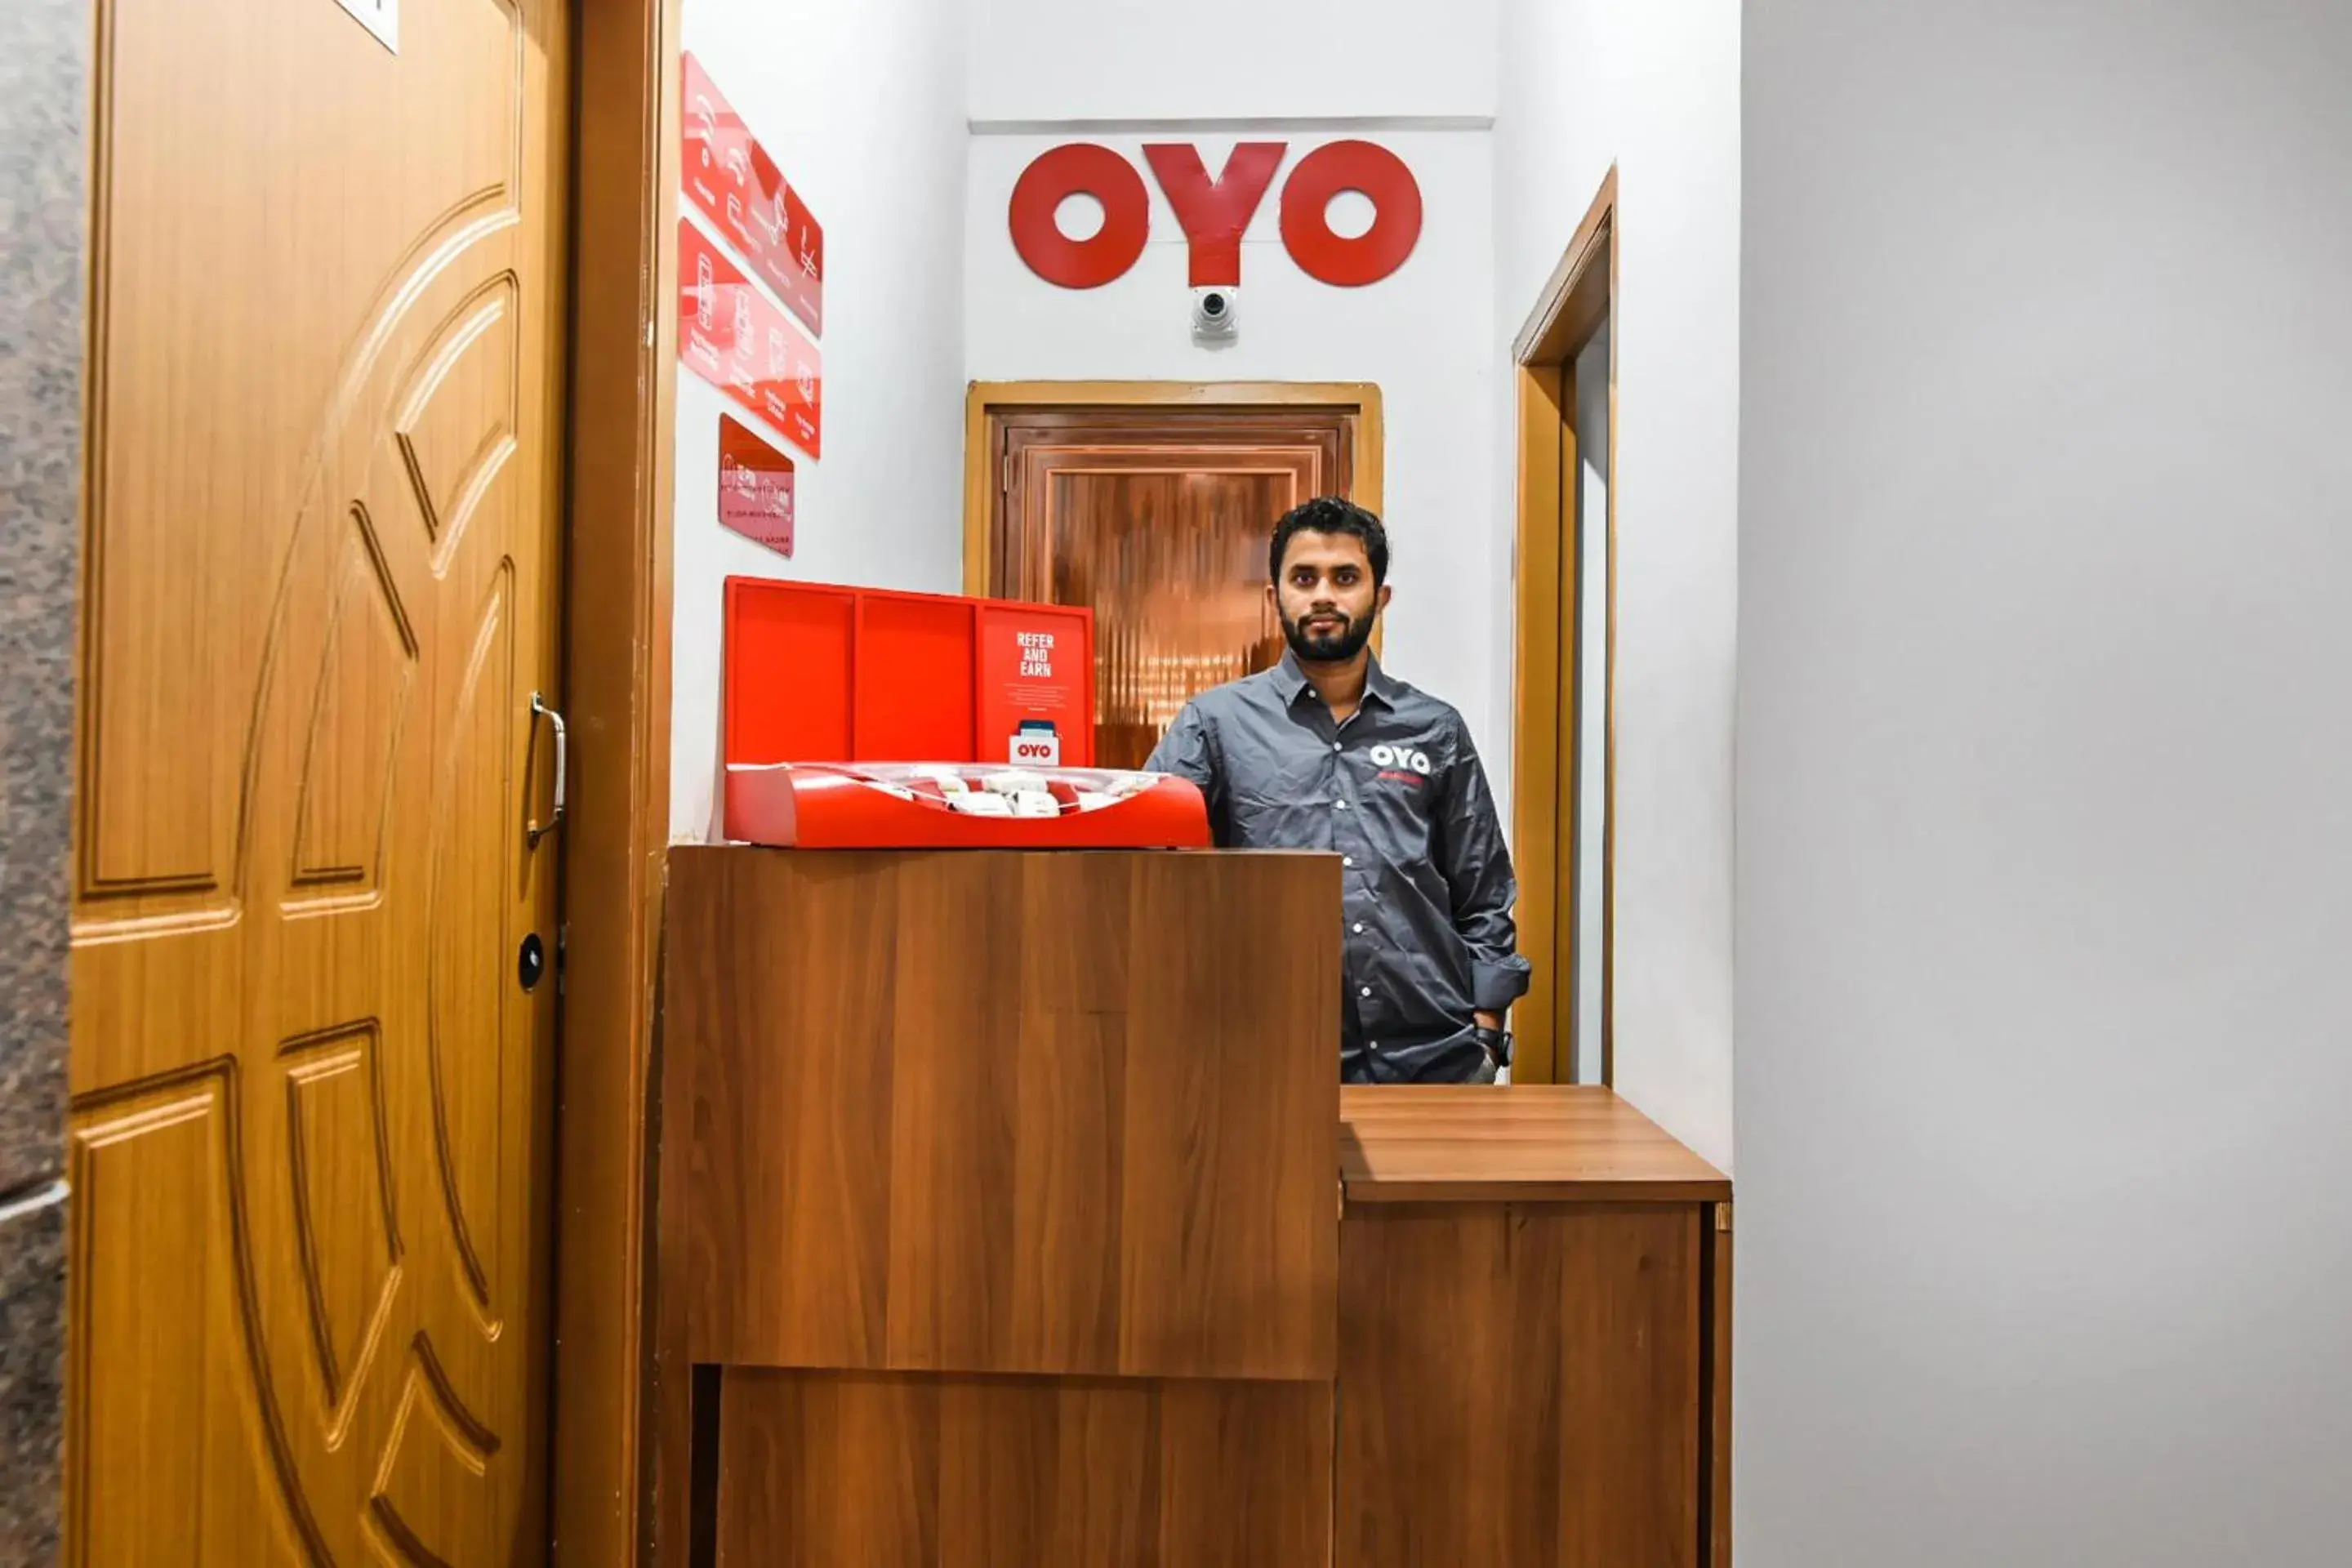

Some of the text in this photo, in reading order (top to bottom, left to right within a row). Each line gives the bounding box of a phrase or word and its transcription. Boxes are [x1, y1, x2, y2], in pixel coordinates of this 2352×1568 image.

[1009, 139, 1423, 288] OYO
[1017, 632, 1054, 648] REFER
[1023, 648, 1049, 662] AND
[1020, 661, 1052, 678] EARN
[1018, 744, 1051, 758] OYO
[1370, 745, 1431, 775] OYO
